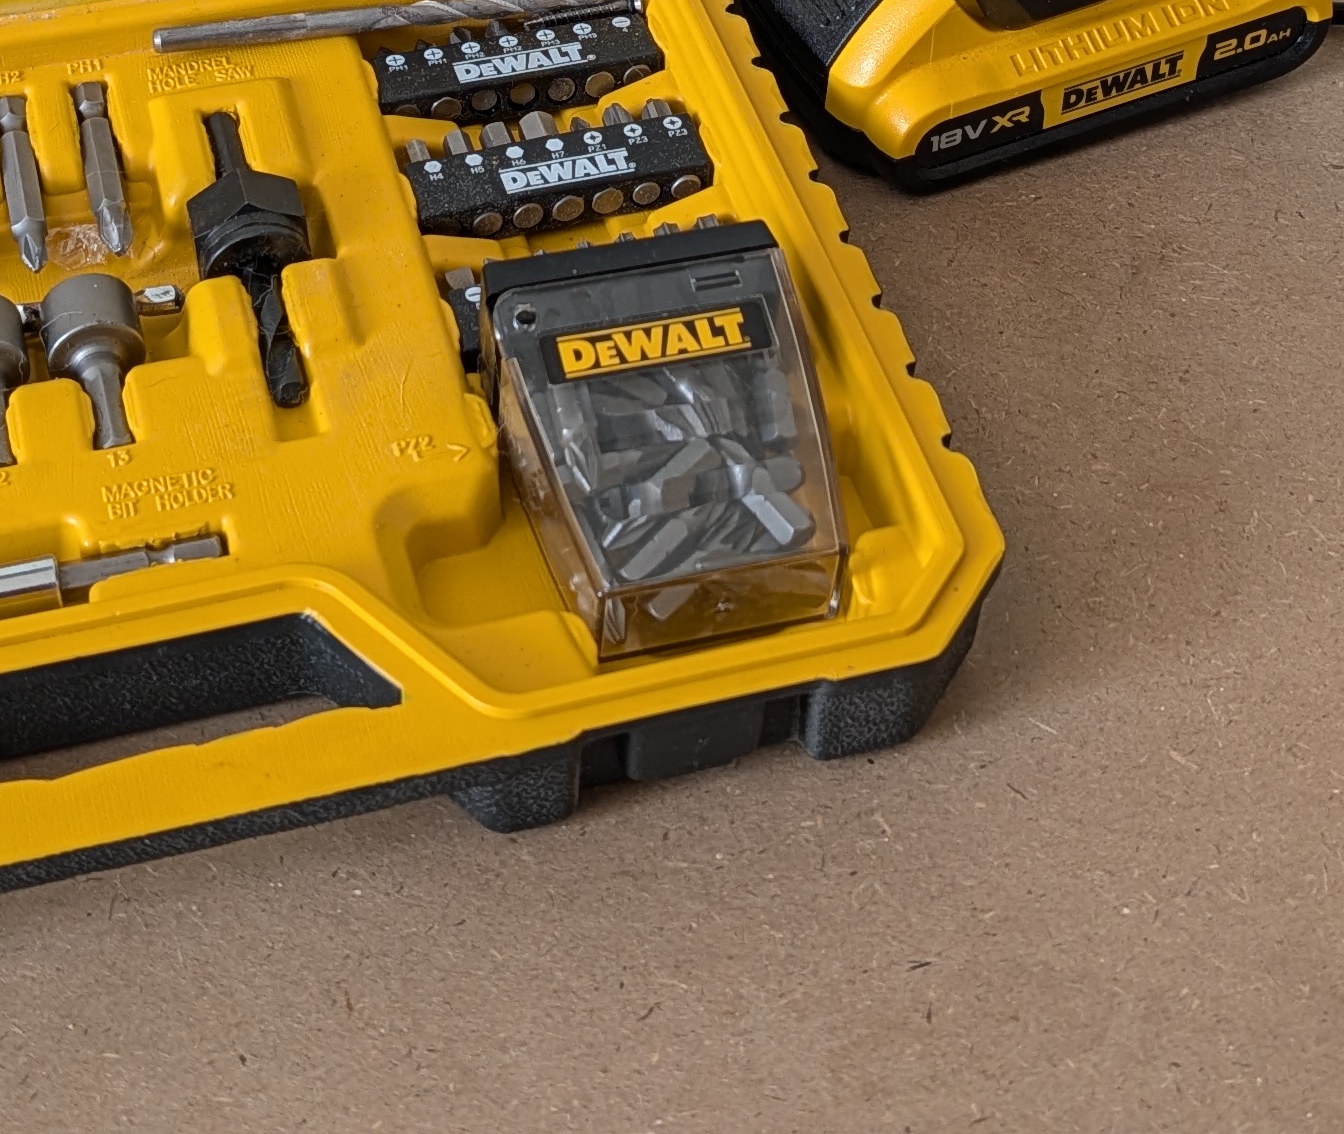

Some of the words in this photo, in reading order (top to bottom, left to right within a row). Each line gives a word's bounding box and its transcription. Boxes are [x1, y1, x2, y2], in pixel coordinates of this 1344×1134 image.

[456, 43, 583, 83] DEWALT
[1010, 11, 1160, 77] LITHIUM
[66, 59, 103, 76] PH1
[147, 57, 235, 80] MANDREL
[148, 75, 198, 94] HOLE
[214, 66, 253, 82] SAW
[1061, 54, 1183, 112] DEWALT
[930, 119, 988, 152] 18V
[990, 107, 1030, 132] XR
[500, 151, 628, 191] DEWALT
[557, 314, 744, 373] DEWALT
[107, 450, 131, 467] 13
[101, 469, 215, 503] MAGNETIC
[107, 501, 138, 520] BIT
[156, 484, 233, 512] HOLDER
